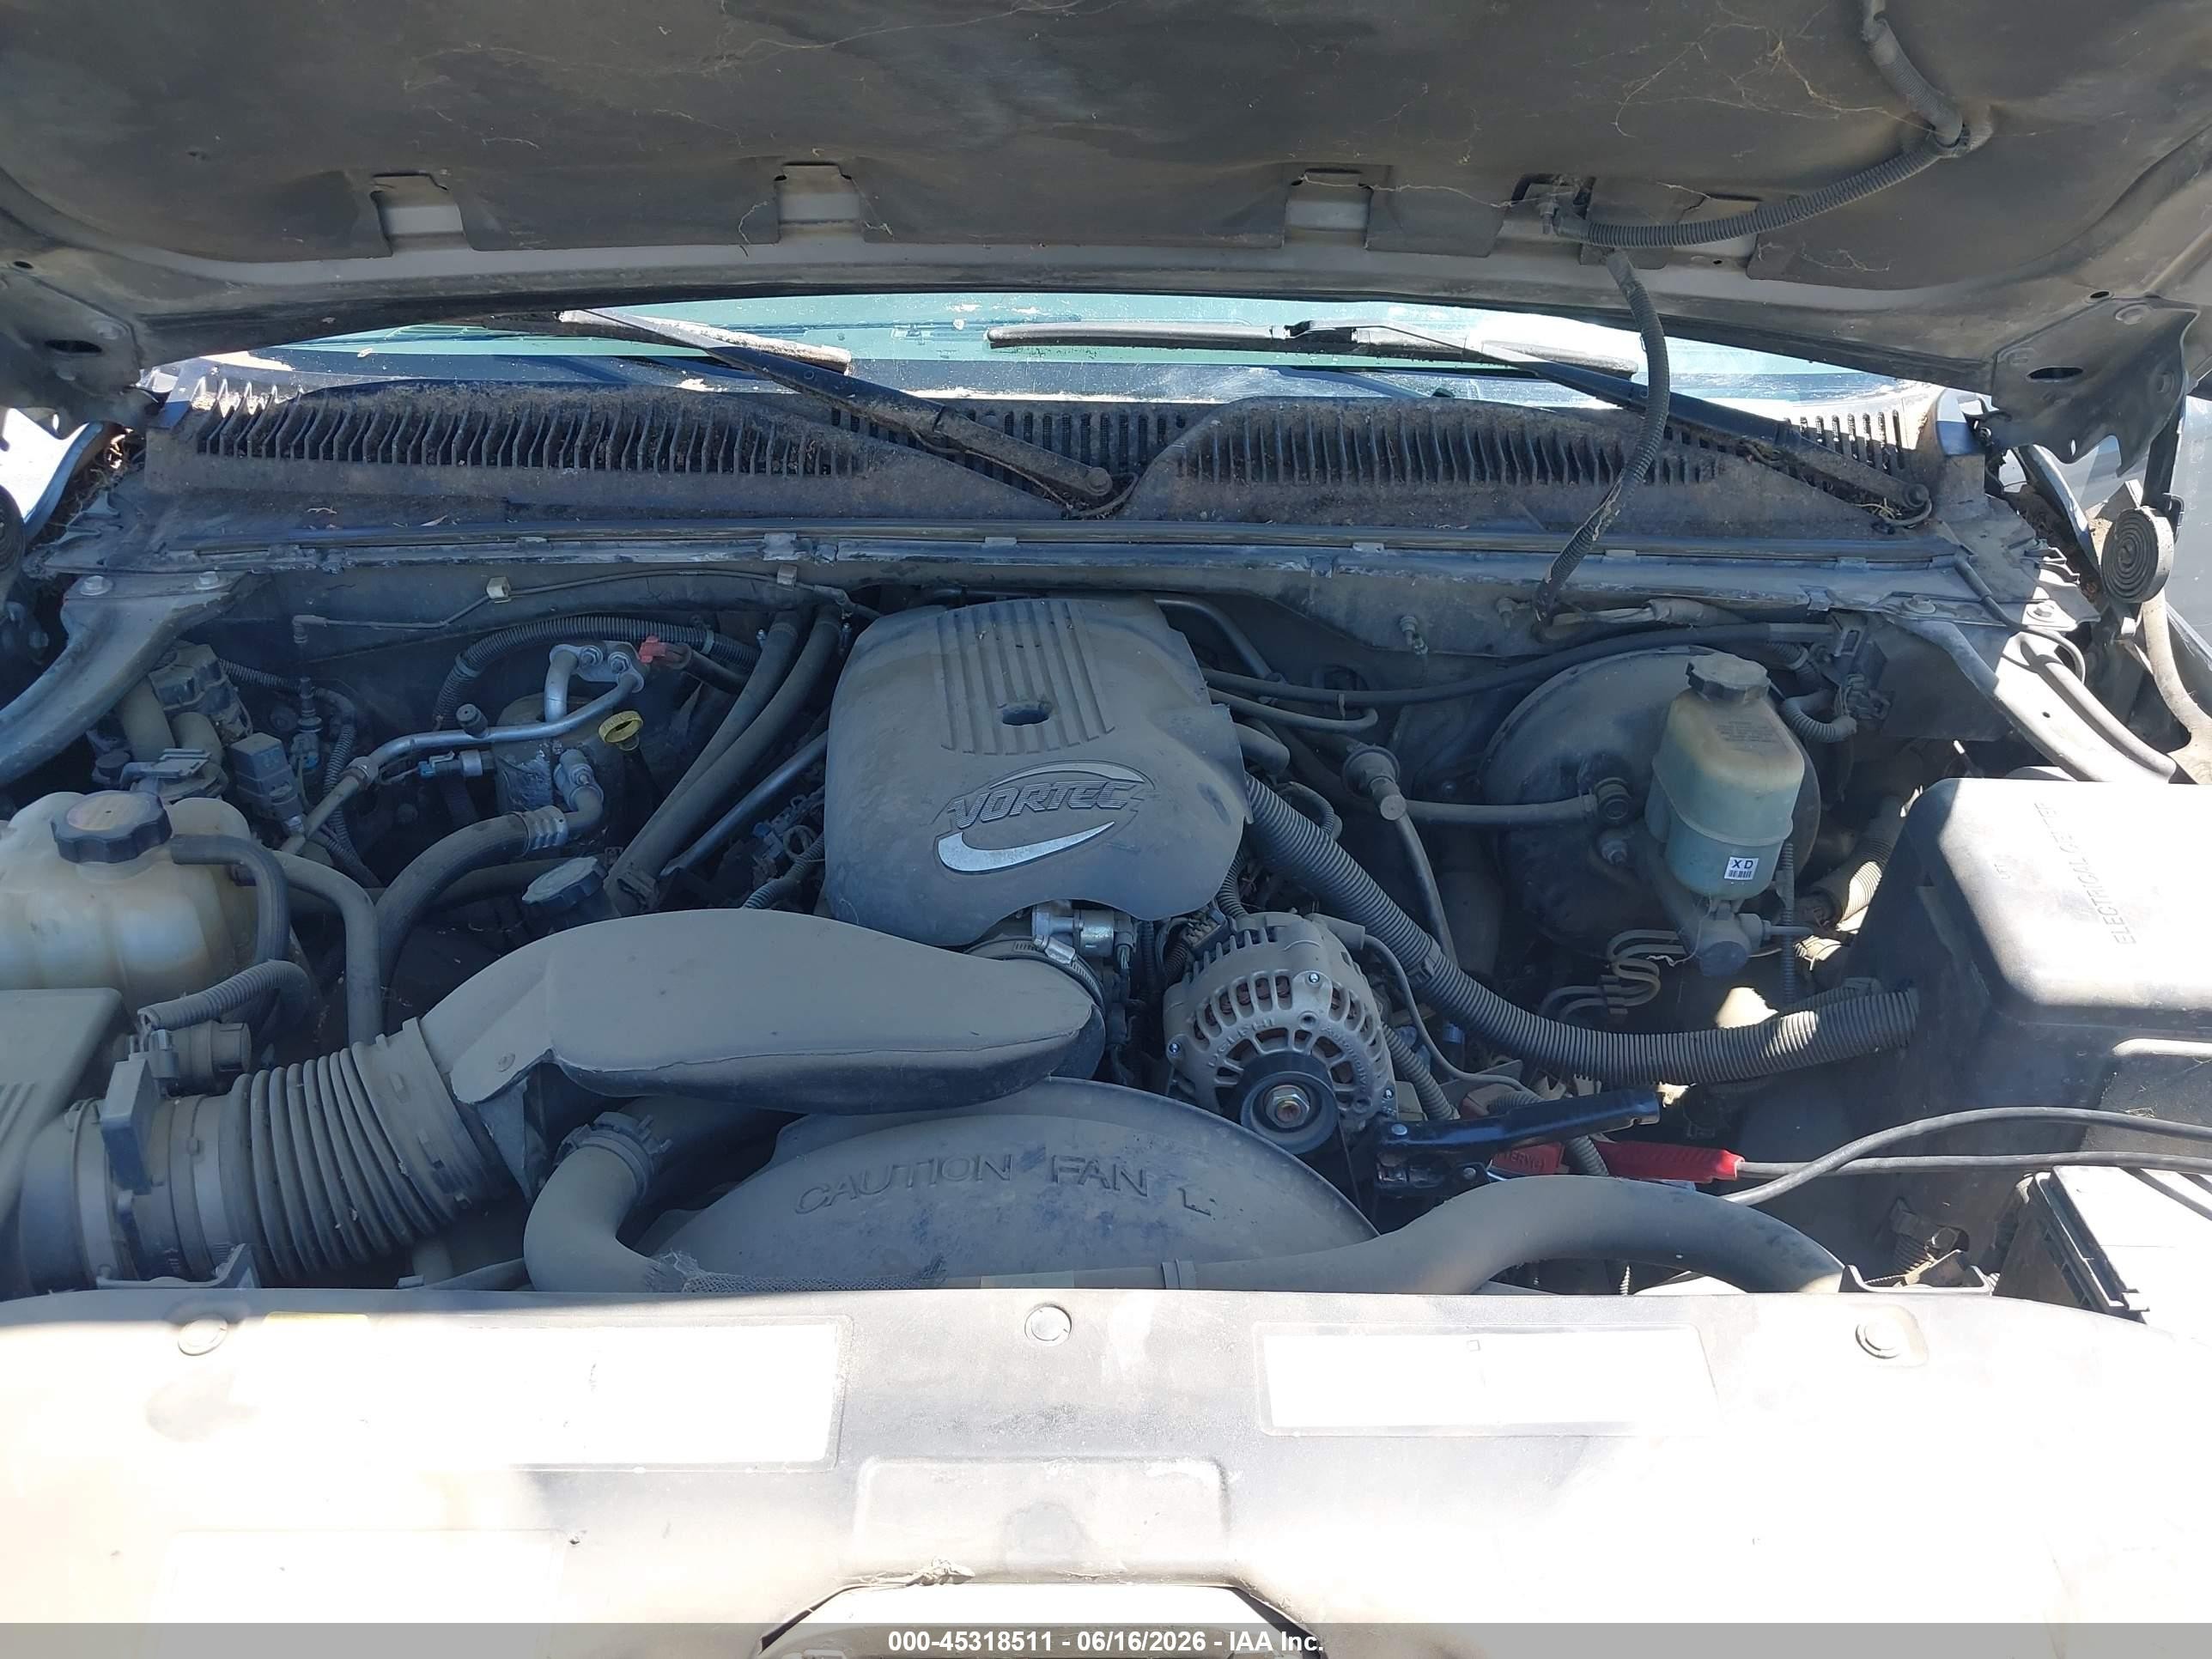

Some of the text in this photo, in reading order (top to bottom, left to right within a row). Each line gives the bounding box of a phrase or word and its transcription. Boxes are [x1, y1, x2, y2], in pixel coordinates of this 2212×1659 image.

[948, 780, 1136, 829] VORTEC
[794, 1153, 1149, 1215] CAUTION FAN
